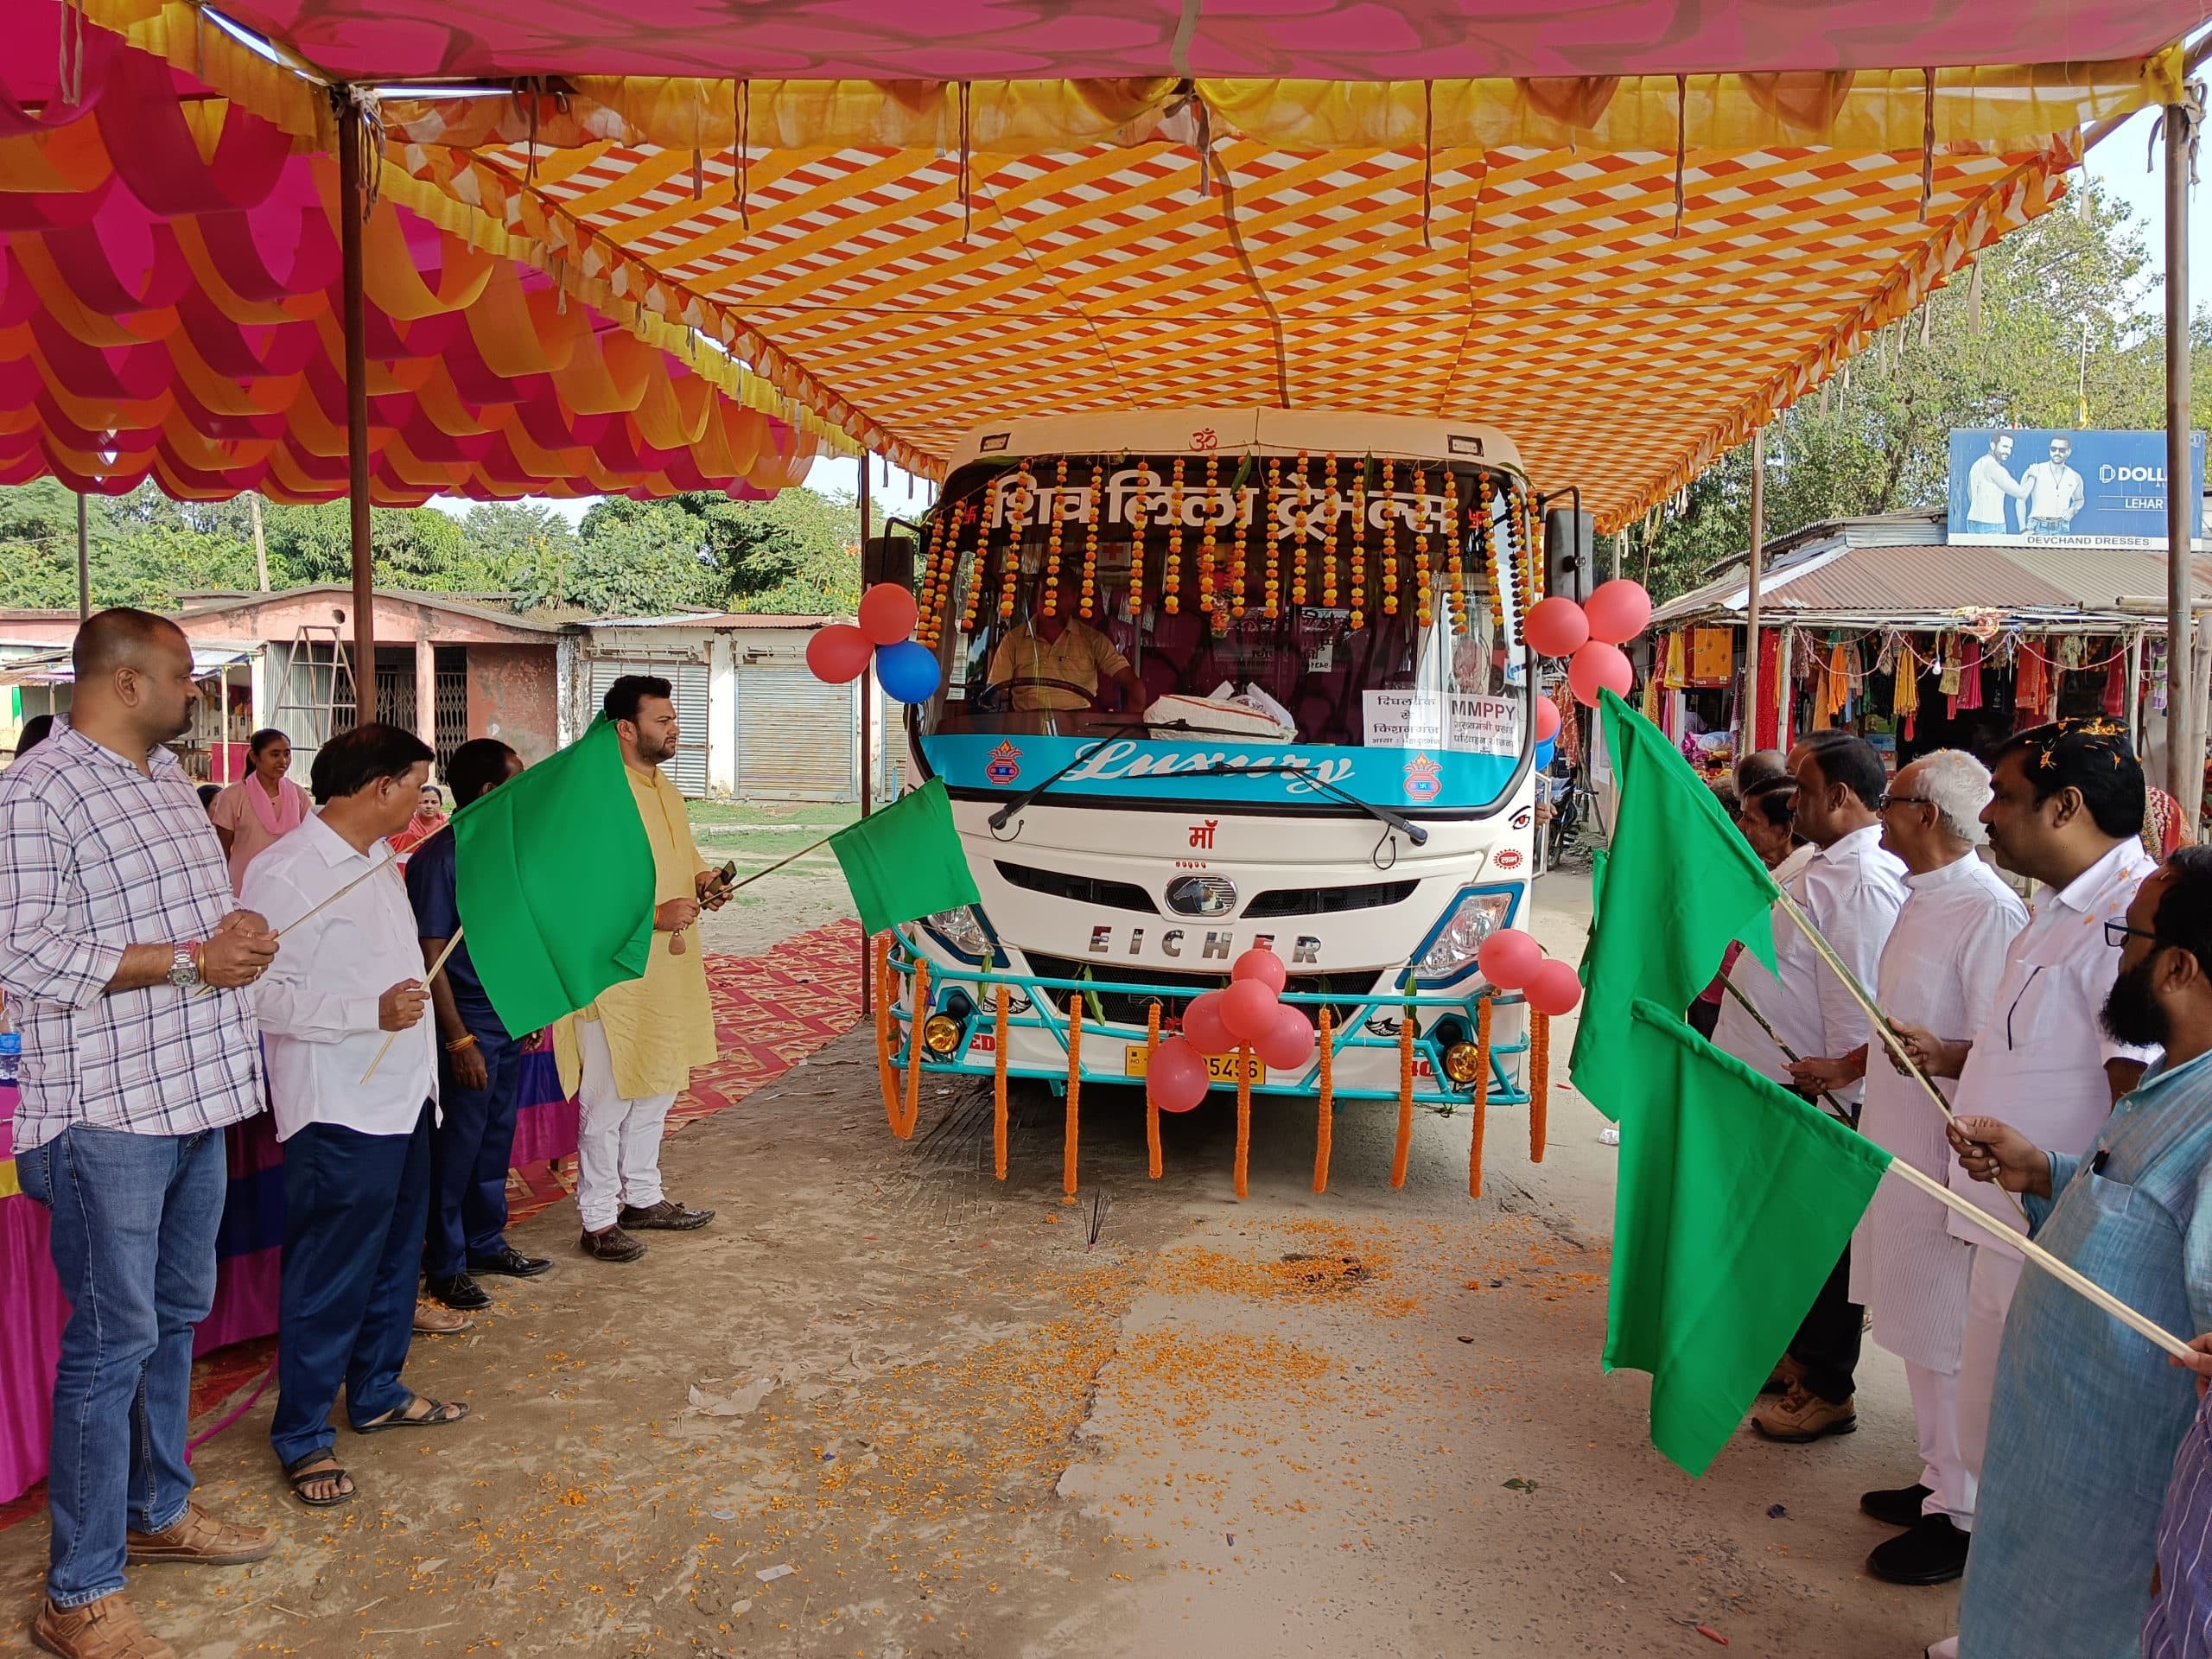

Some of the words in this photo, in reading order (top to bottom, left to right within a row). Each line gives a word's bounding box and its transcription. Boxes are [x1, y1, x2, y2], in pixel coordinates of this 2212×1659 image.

[2118, 467, 2167, 481] DOLL
[2125, 498, 2164, 510] LEHAR
[2027, 536, 2092, 545] DEVCHAND
[2094, 537, 2150, 546] DRESSES
[1452, 700, 1516, 721] MMPPY
[1059, 741, 1356, 794] Luxury
[1089, 926, 1322, 963] EICHER
